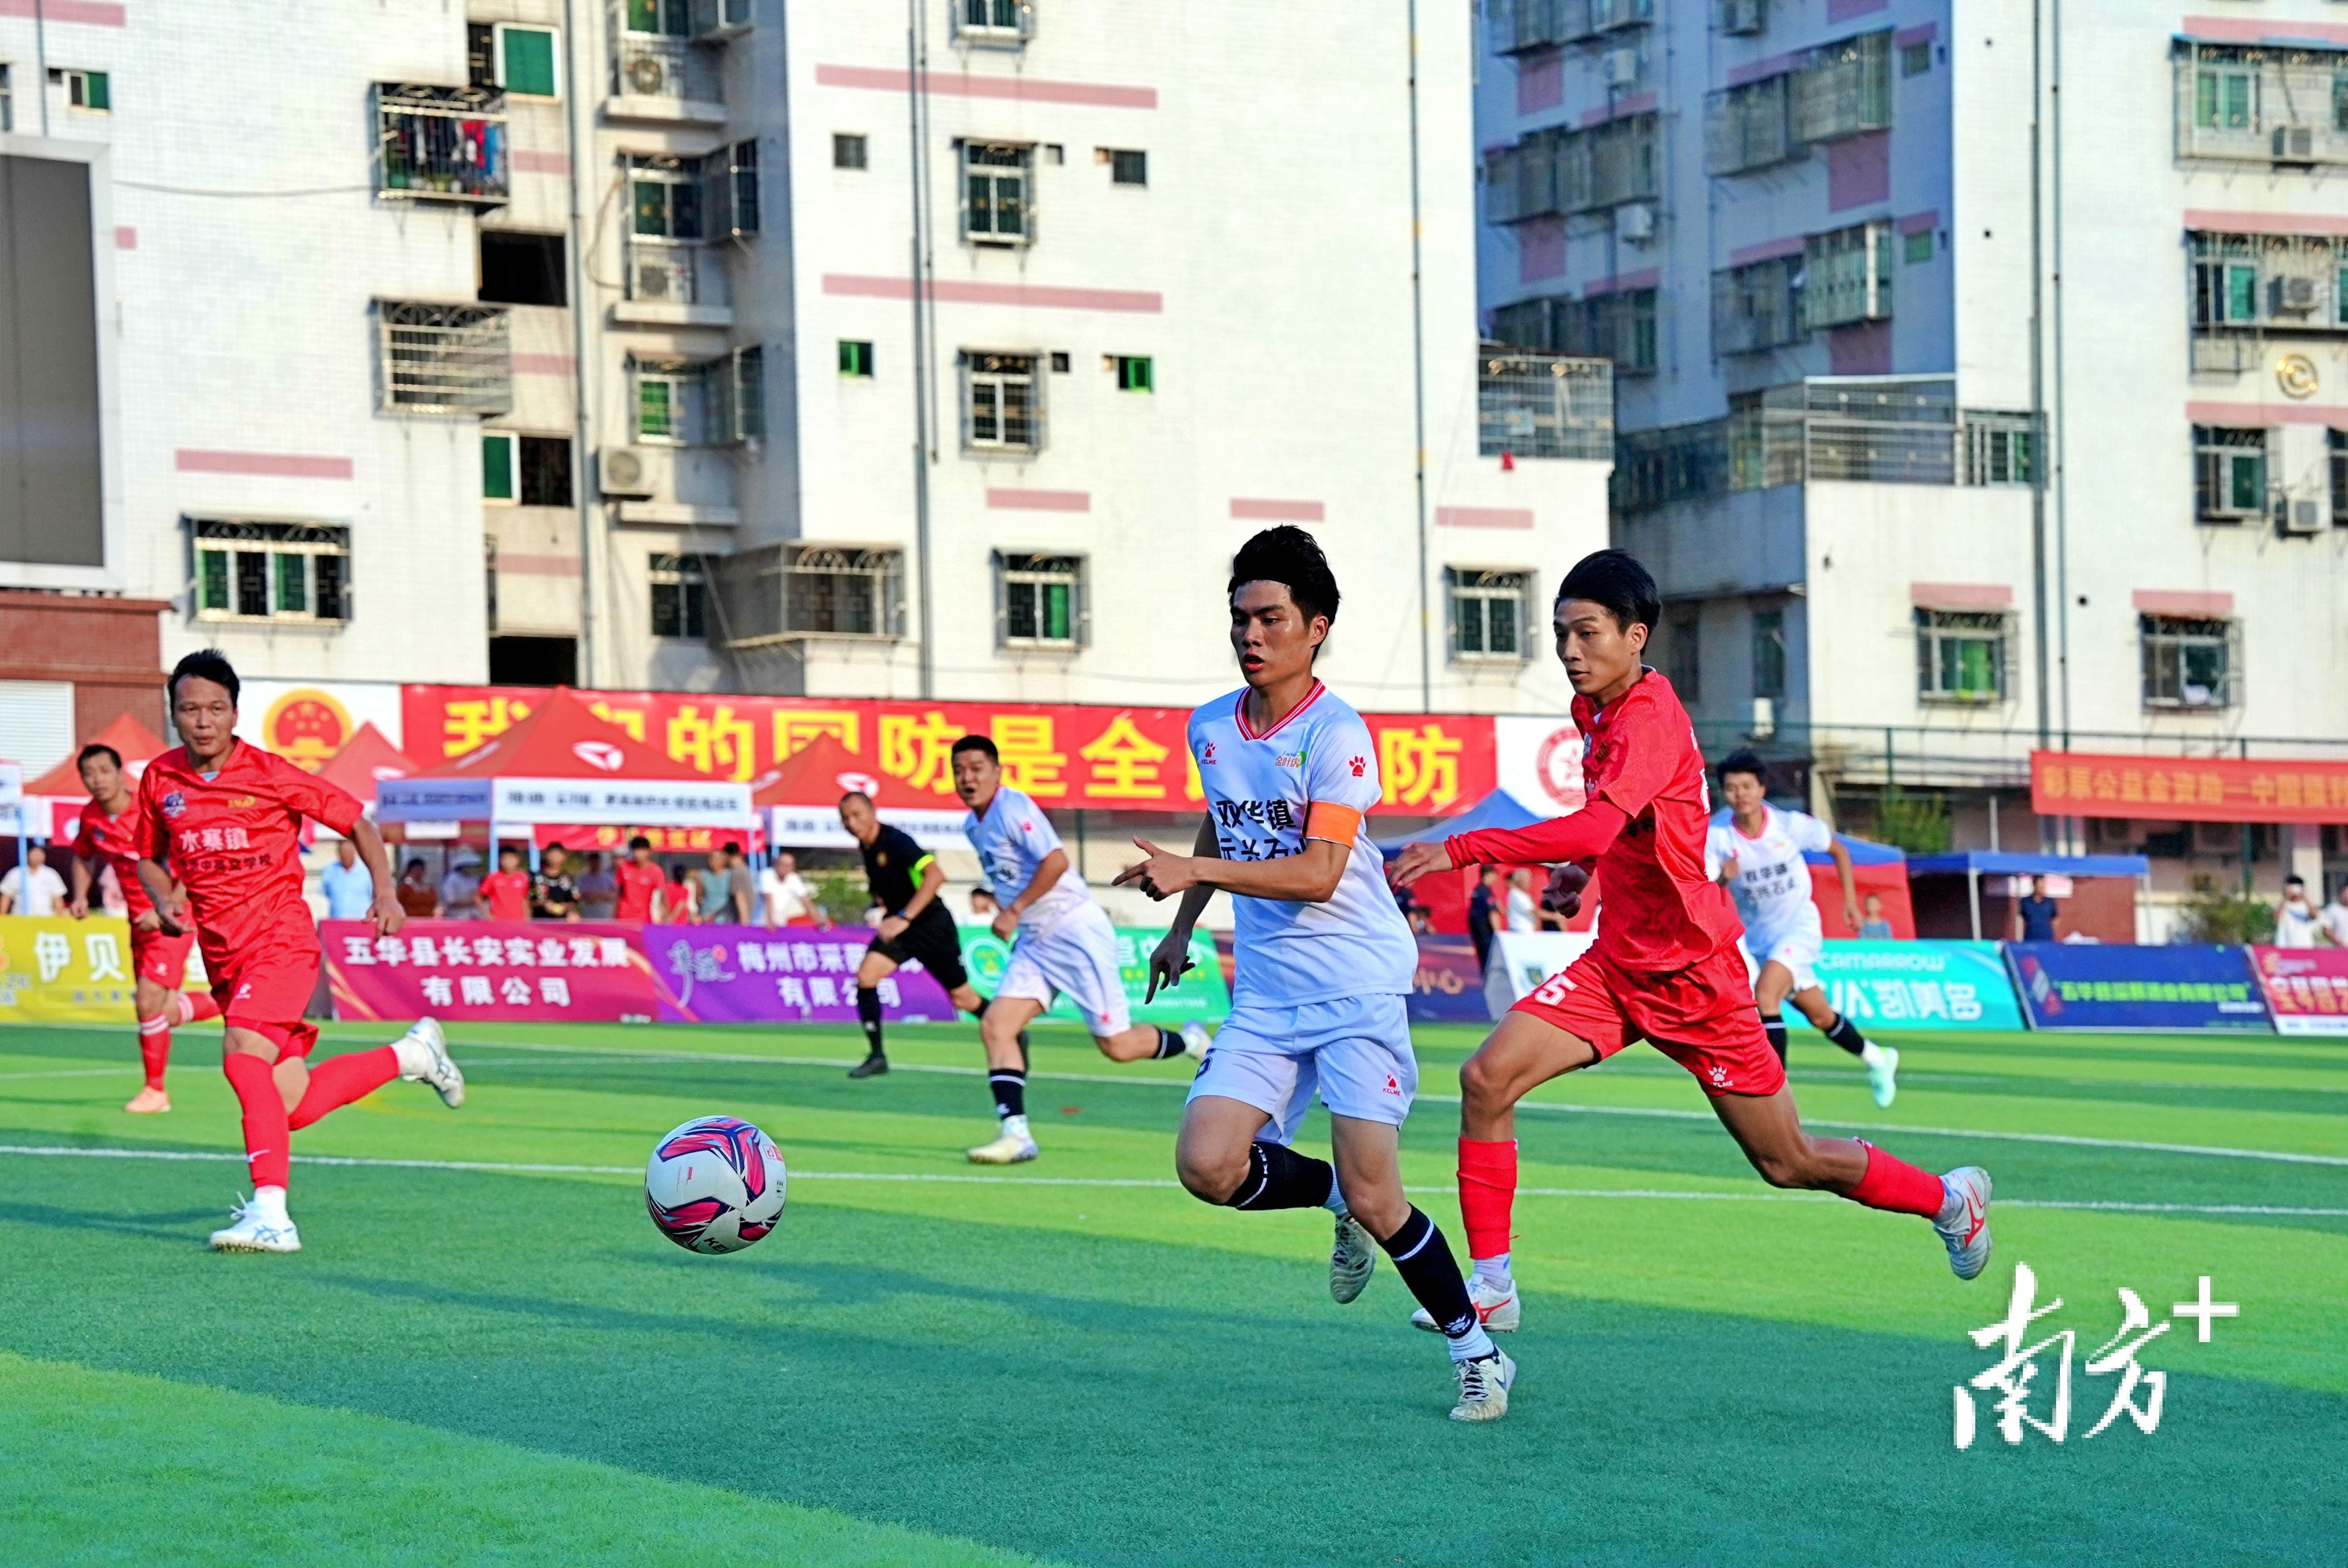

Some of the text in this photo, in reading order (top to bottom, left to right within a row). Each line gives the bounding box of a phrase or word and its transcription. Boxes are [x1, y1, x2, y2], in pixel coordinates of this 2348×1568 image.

[1216, 799, 1296, 831] 双华镇
[179, 827, 250, 852] 水寨镇
[343, 936, 630, 967] 五华县长安实业发展
[420, 975, 570, 1006] 有限公司
[777, 976, 901, 1008] 有限公司
[1534, 974, 1578, 1006] 5
